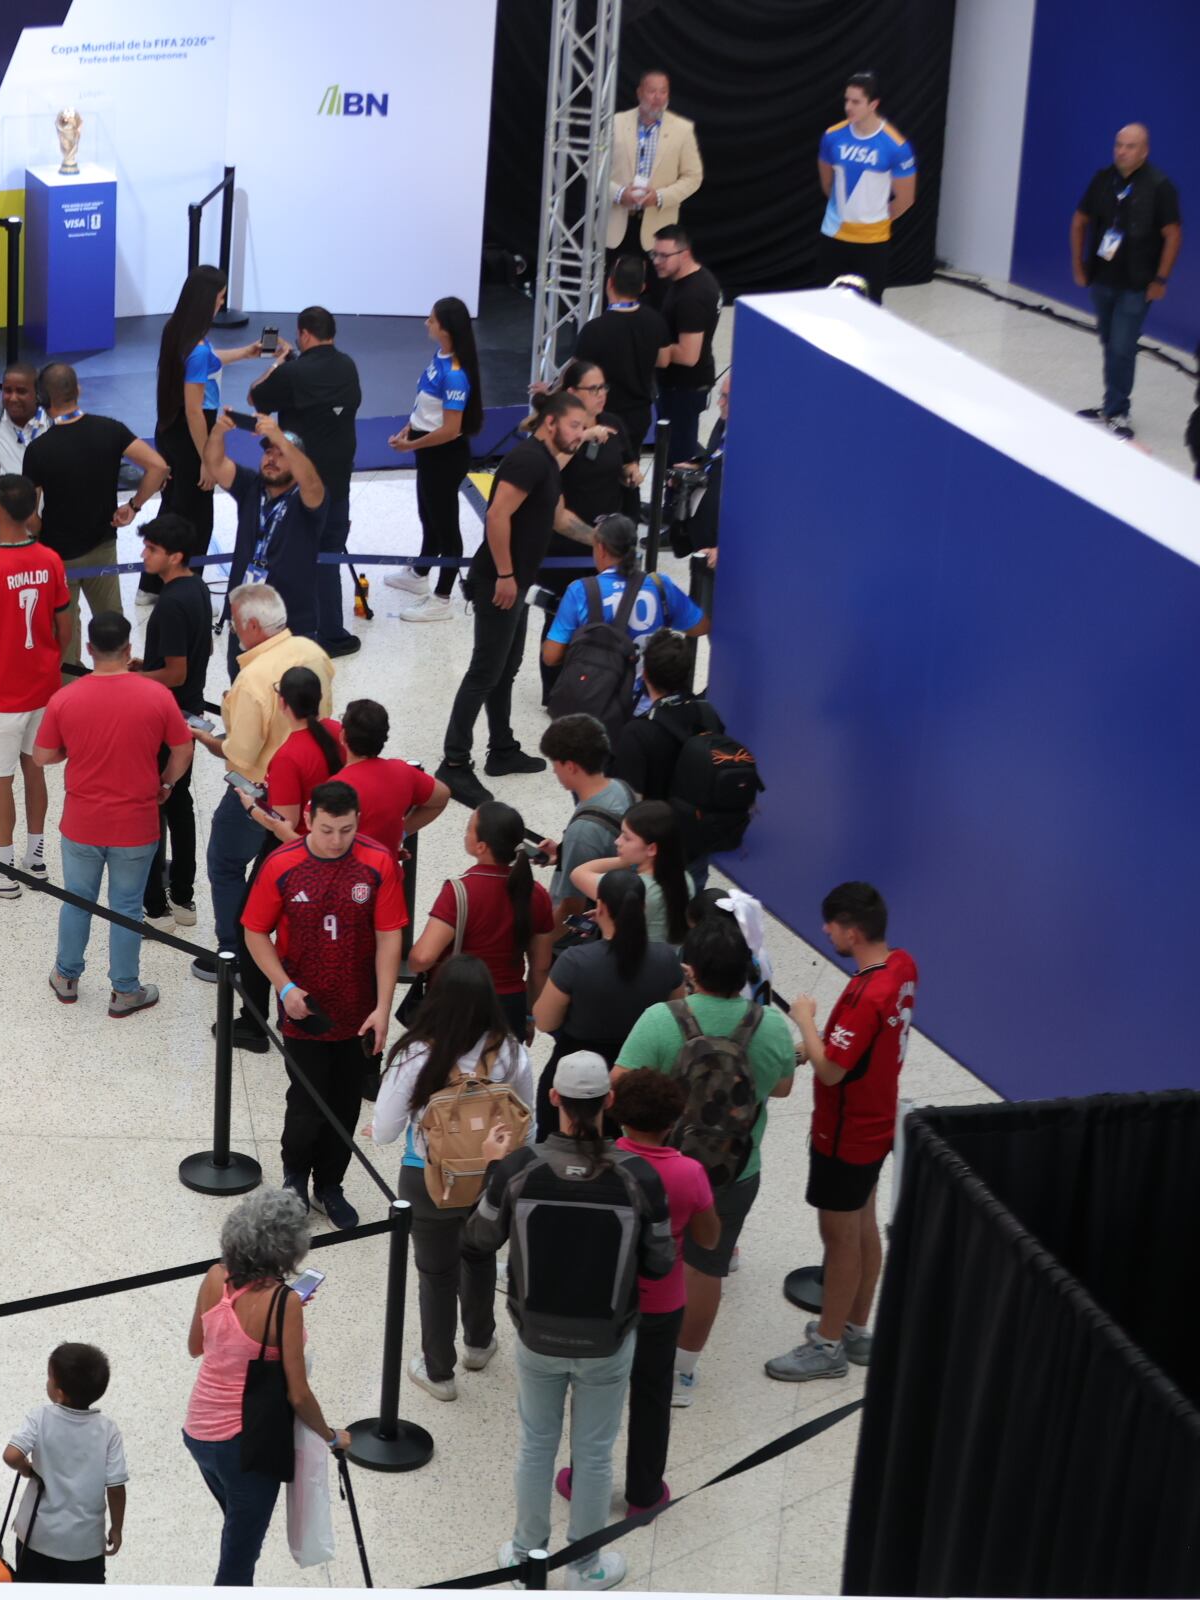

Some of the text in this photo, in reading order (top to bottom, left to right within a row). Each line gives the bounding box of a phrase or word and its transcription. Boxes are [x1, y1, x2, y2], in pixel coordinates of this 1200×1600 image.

[51, 45, 79, 56] Copa
[82, 40, 125, 53] Mundial
[127, 39, 141, 50] de
[143, 38, 152, 49] la
[155, 38, 177, 48] FIFA
[78, 52, 188, 64] Trofeo de los Campeones
[343, 92, 389, 117] BN
[838, 144, 878, 166] VISA
[64, 218, 85, 229] VISA
[446, 390, 466, 402] VISA
[7, 569, 49, 590] RONALDO
[19, 588, 39, 649] 7
[323, 914, 337, 940] 9
